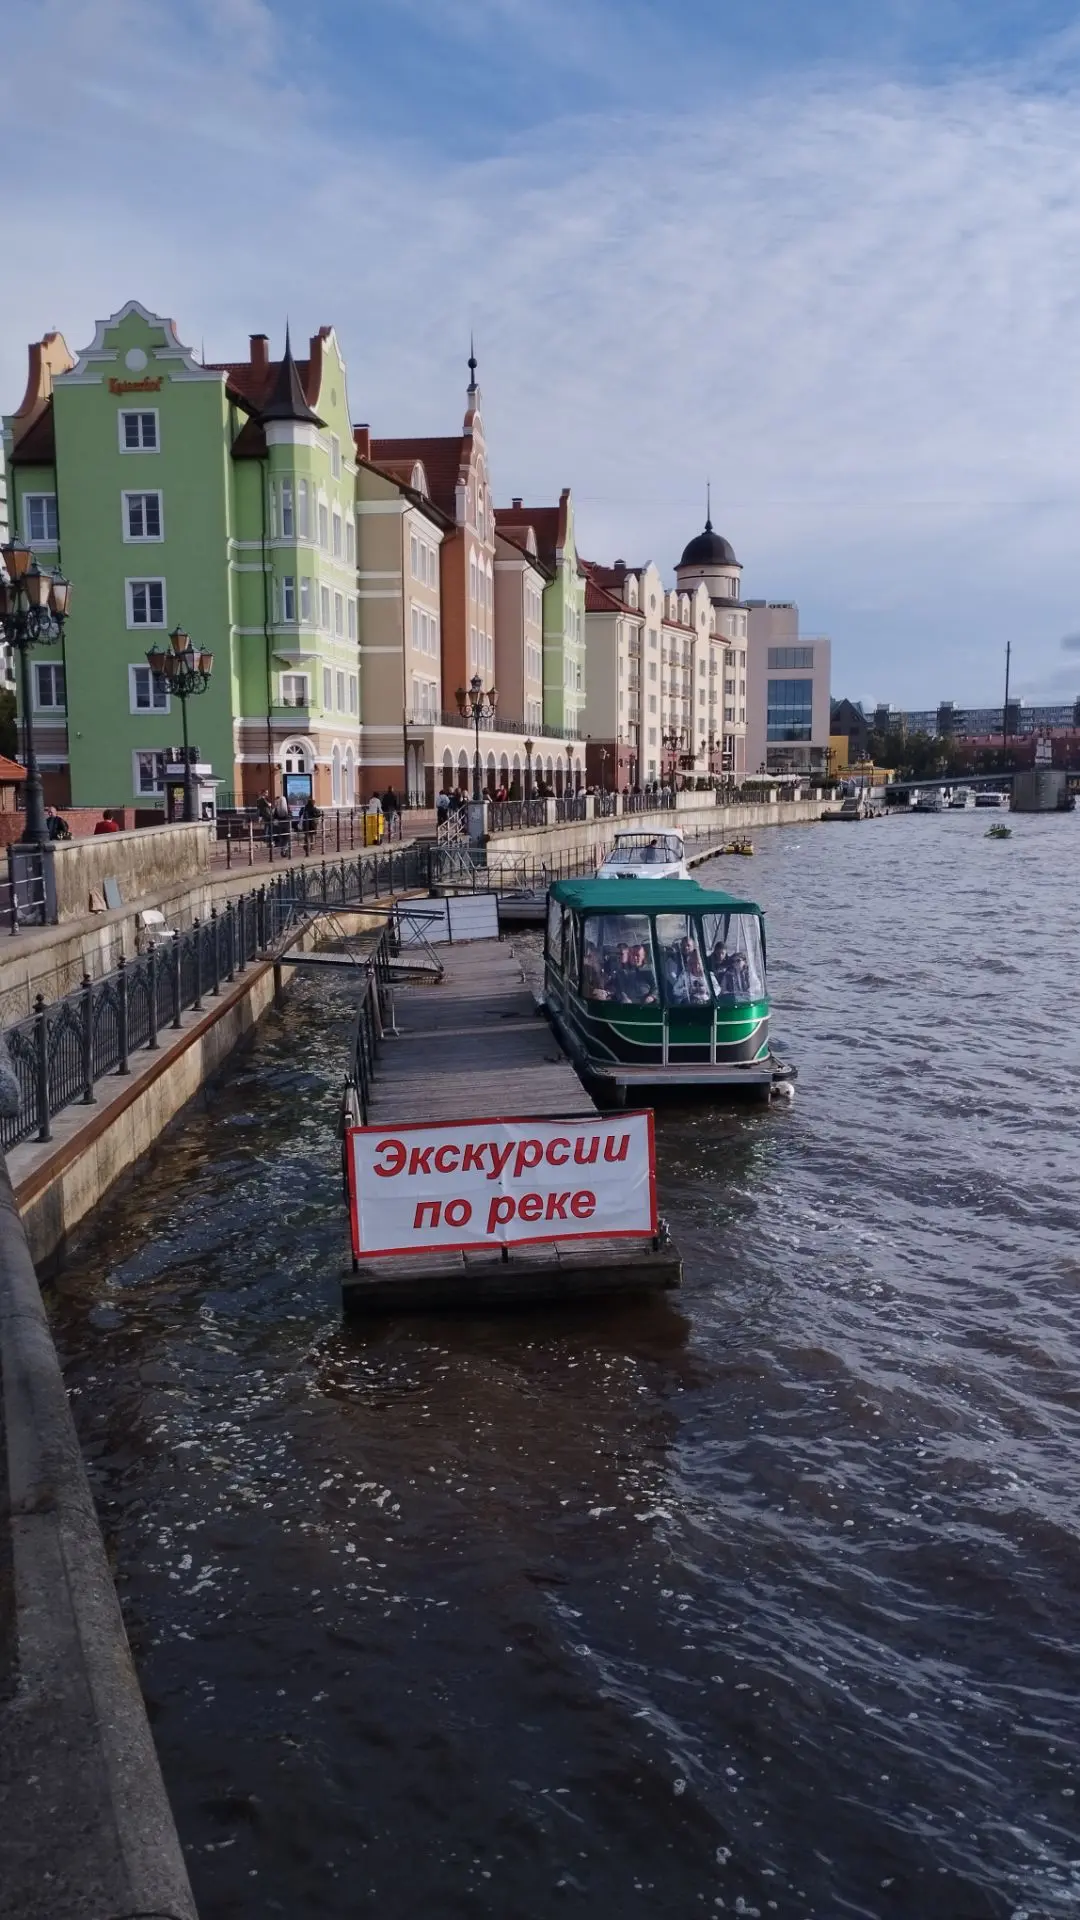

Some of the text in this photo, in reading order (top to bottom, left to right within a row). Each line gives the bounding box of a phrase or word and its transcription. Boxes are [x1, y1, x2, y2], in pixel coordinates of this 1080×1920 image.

[374, 1134, 630, 1179] Экскурсии
[413, 1190, 597, 1234] по реке
